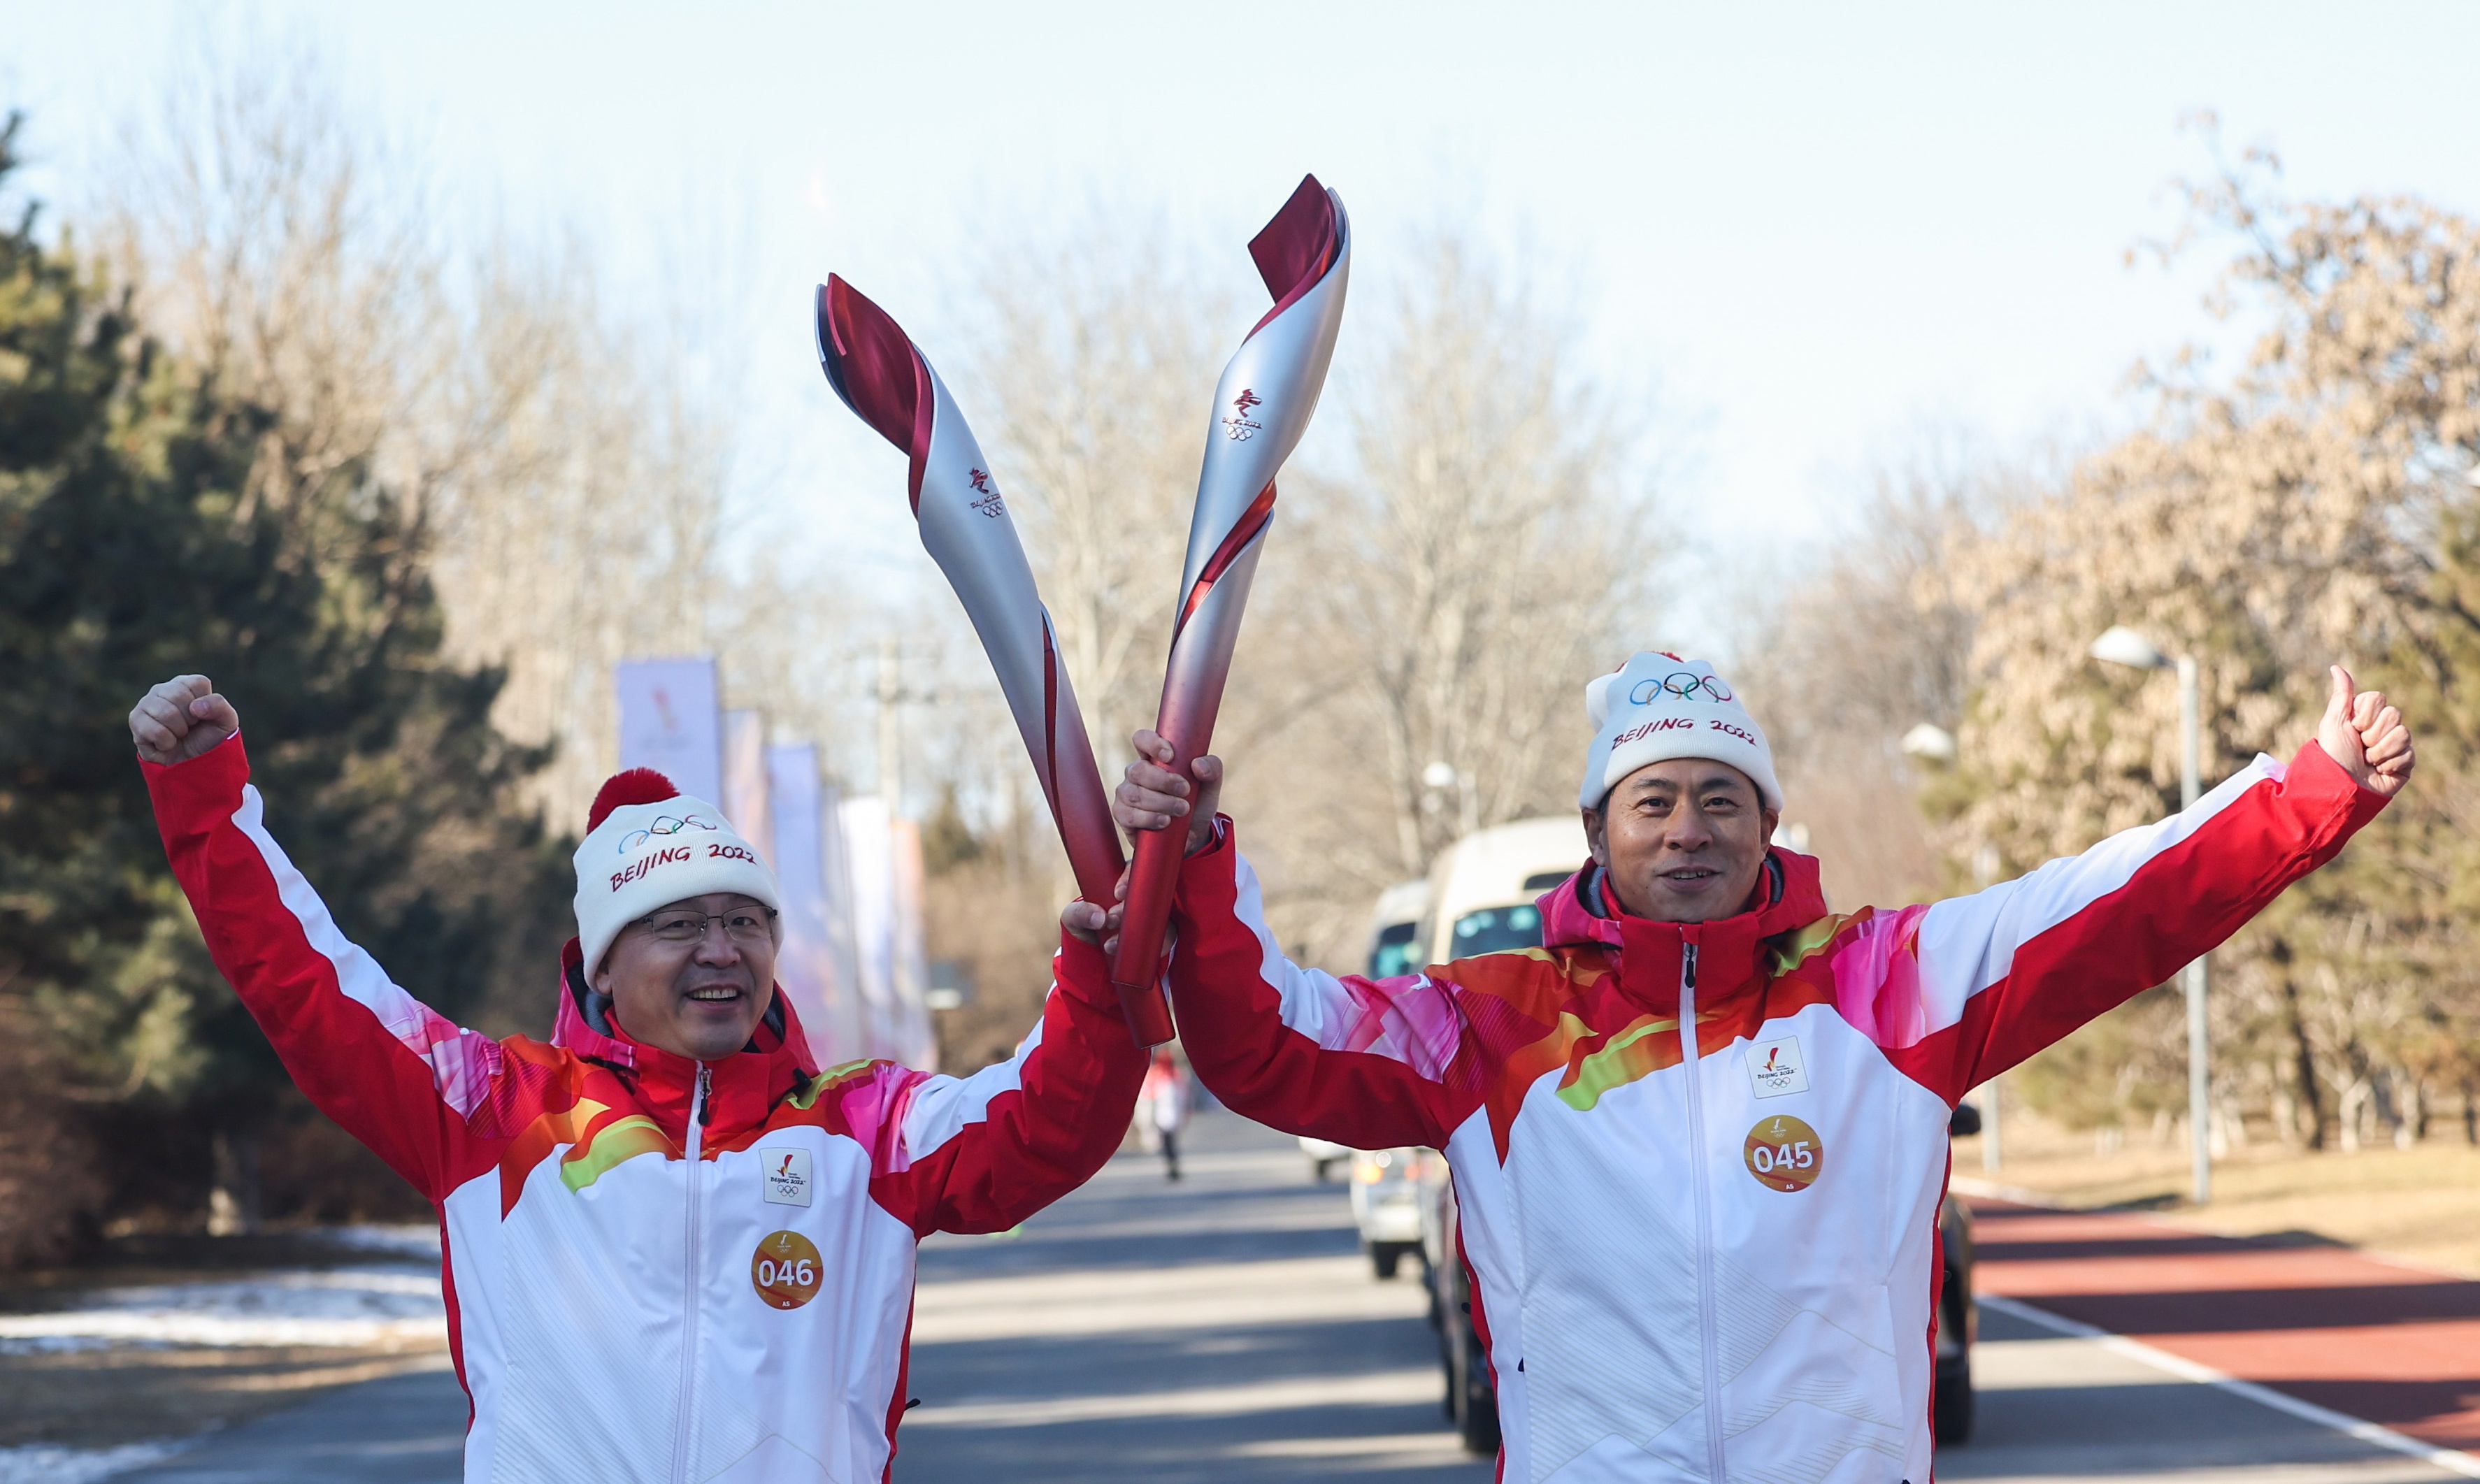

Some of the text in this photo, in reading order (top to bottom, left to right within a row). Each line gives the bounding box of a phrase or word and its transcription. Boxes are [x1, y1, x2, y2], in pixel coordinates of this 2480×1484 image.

[1611, 718, 1757, 751] BEIJING 2022
[610, 844, 757, 893] BEIJING 2022
[1753, 1140, 1814, 1173] 045
[758, 1259, 814, 1287] 046
